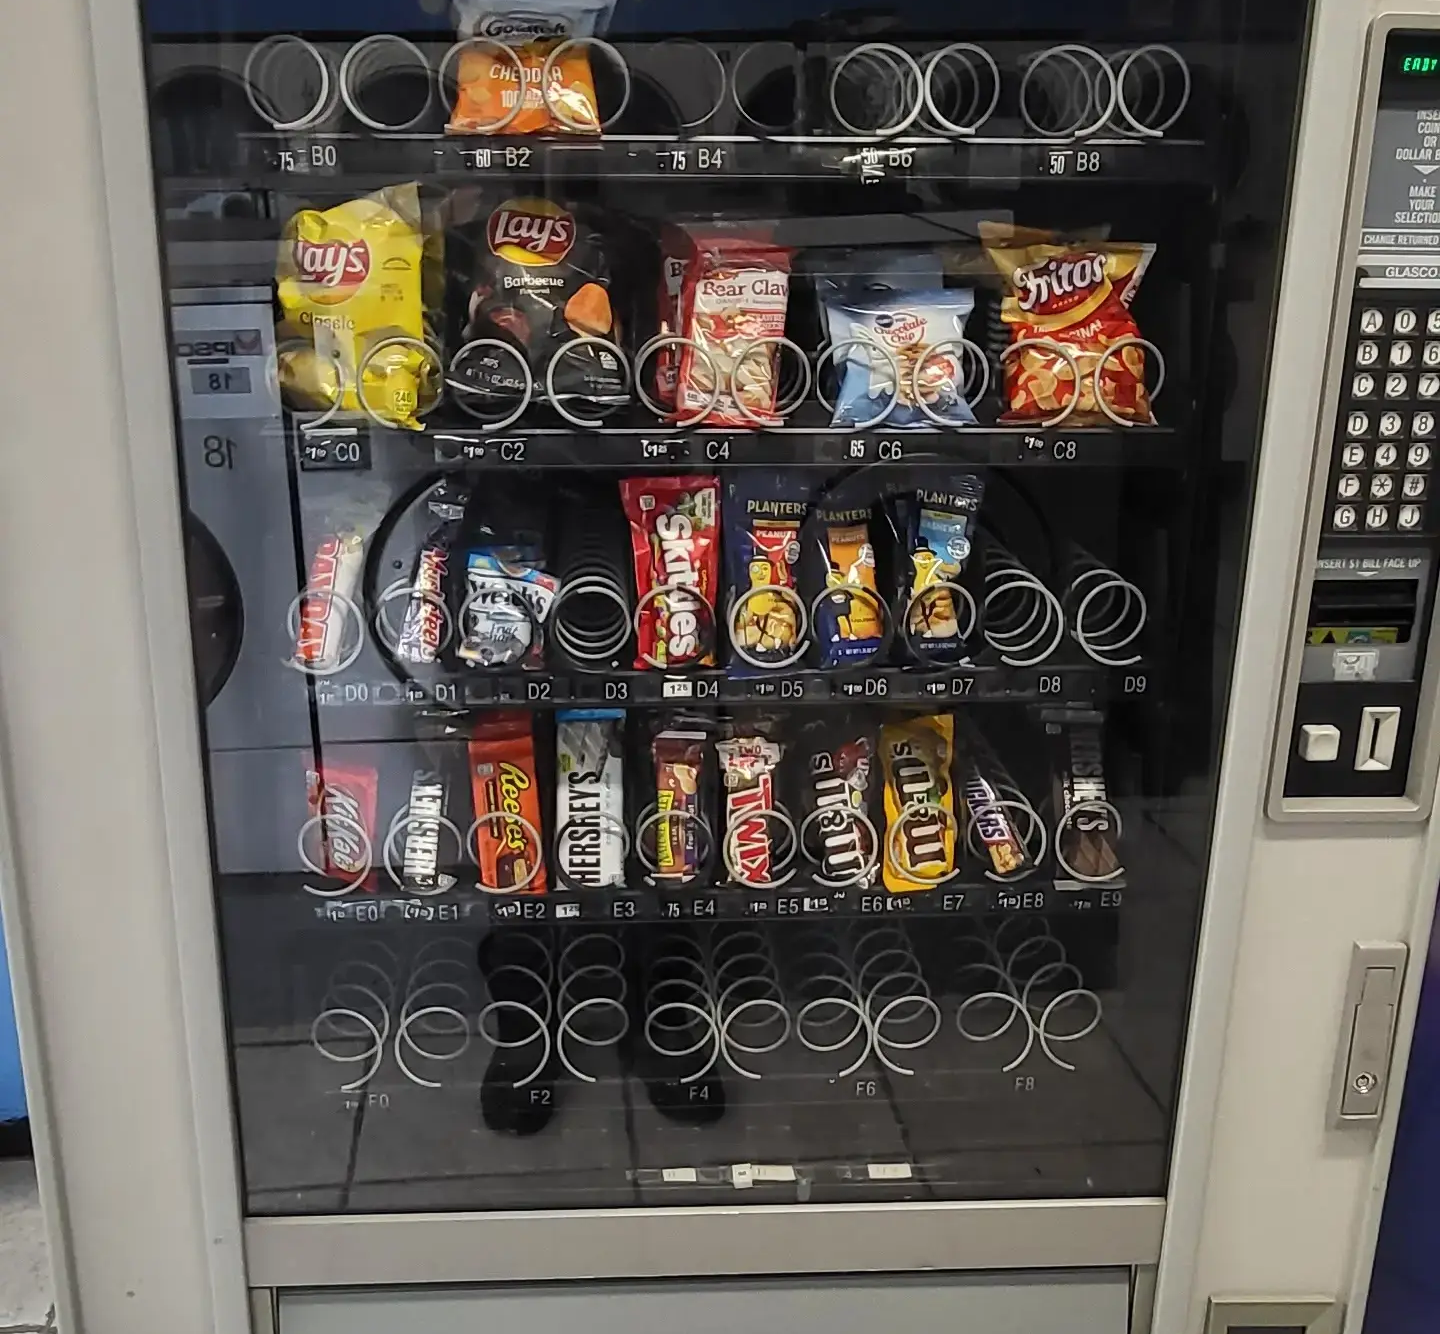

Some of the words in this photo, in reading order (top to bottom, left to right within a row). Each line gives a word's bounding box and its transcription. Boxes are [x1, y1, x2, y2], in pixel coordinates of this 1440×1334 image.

[1423, 136, 1438, 147] OR
[311, 145, 338, 167] B0
[505, 145, 532, 168] B2
[698, 148, 723, 169] B4
[1076, 151, 1101, 172] B8
[1395, 149, 1432, 160] DOLLAR
[1408, 185, 1437, 197] MAKE
[1409, 199, 1435, 211] YOUR
[494, 211, 571, 252] Lay's
[1363, 234, 1396, 244] CHANGE
[1398, 235, 1439, 245] RETURNED
[503, 274, 565, 289] Barbecue
[1013, 254, 1107, 310] Fritos
[1365, 312, 1377, 329] A
[1400, 312, 1411, 329] 0
[890, 332, 915, 344] Chip
[1361, 344, 1373, 362] B
[1428, 344, 1439, 362] 6
[1357, 376, 1369, 393] C
[1390, 376, 1402, 393] 2
[1424, 376, 1435, 393] 7
[1352, 416, 1364, 432] D
[1385, 416, 1396, 433] 3
[1418, 415, 1429, 432] 8
[335, 442, 360, 461] C0
[500, 442, 525, 461] C2
[706, 441, 730, 460] C4
[878, 440, 902, 460] C6
[1053, 441, 1077, 460] C8
[1348, 447, 1359, 463] E
[1381, 446, 1391, 463] 4
[1414, 446, 1425, 463] 9
[1344, 478, 1355, 494] F
[747, 499, 808, 516] PLANTERS
[917, 489, 978, 512] PLANTERS
[1340, 508, 1352, 525] G
[1371, 508, 1384, 524] H
[1404, 508, 1415, 524] J
[1362, 558, 1380, 568] BILL
[1383, 558, 1406, 568] FACE
[1408, 558, 1422, 568] UP
[655, 513, 702, 658] Skittles
[345, 684, 369, 702] D0
[435, 684, 457, 701] D1
[528, 682, 551, 700] D2
[605, 682, 628, 700] D3
[696, 681, 719, 698] D4
[781, 680, 804, 698] D5
[865, 678, 888, 696] D6
[952, 677, 975, 695] D7
[1039, 676, 1062, 693] D8
[1124, 676, 1147, 693] D9
[498, 761, 531, 852] Reese's
[567, 770, 602, 885] HERSHEY'S
[729, 773, 773, 884] TWIX
[777, 899, 799, 914] E5
[861, 896, 883, 912] E6
[943, 895, 964, 910] E7
[1023, 893, 1044, 908] E8
[1101, 891, 1122, 907] E9
[356, 907, 378, 921] E0
[438, 905, 459, 920] E1
[524, 903, 546, 917] E2
[613, 902, 635, 917] E3
[693, 900, 715, 916] E4
[856, 1082, 876, 1096] F6
[1015, 1077, 1035, 1091] F8
[530, 1090, 551, 1105] F2
[689, 1086, 709, 1101] F4
